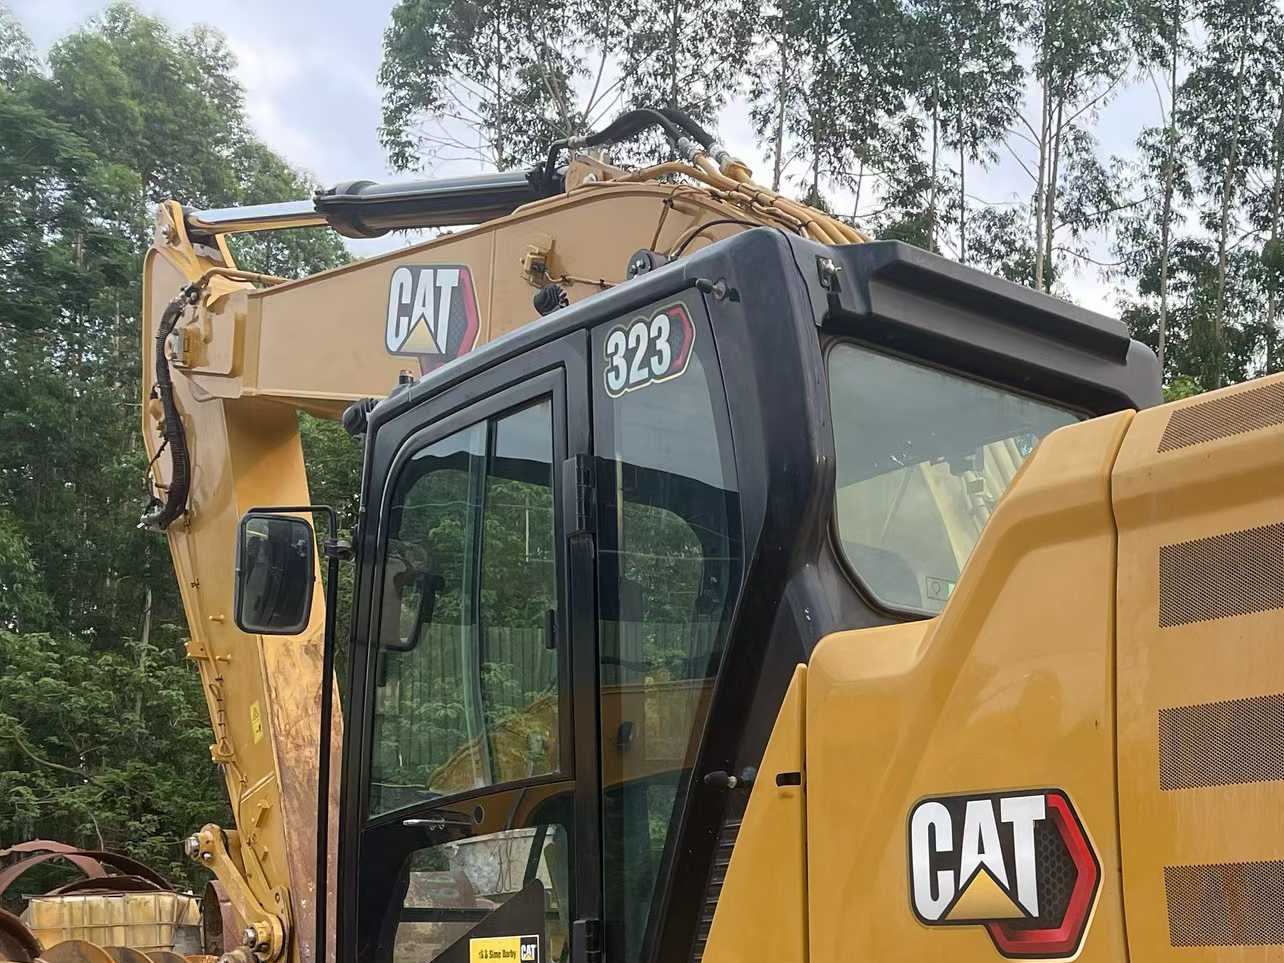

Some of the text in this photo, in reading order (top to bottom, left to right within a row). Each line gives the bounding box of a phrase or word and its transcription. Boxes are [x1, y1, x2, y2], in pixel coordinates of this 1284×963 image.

[386, 268, 460, 354] CAT
[606, 314, 672, 391] 323
[911, 795, 1046, 921] CAT
[521, 944, 536, 961] CAT
